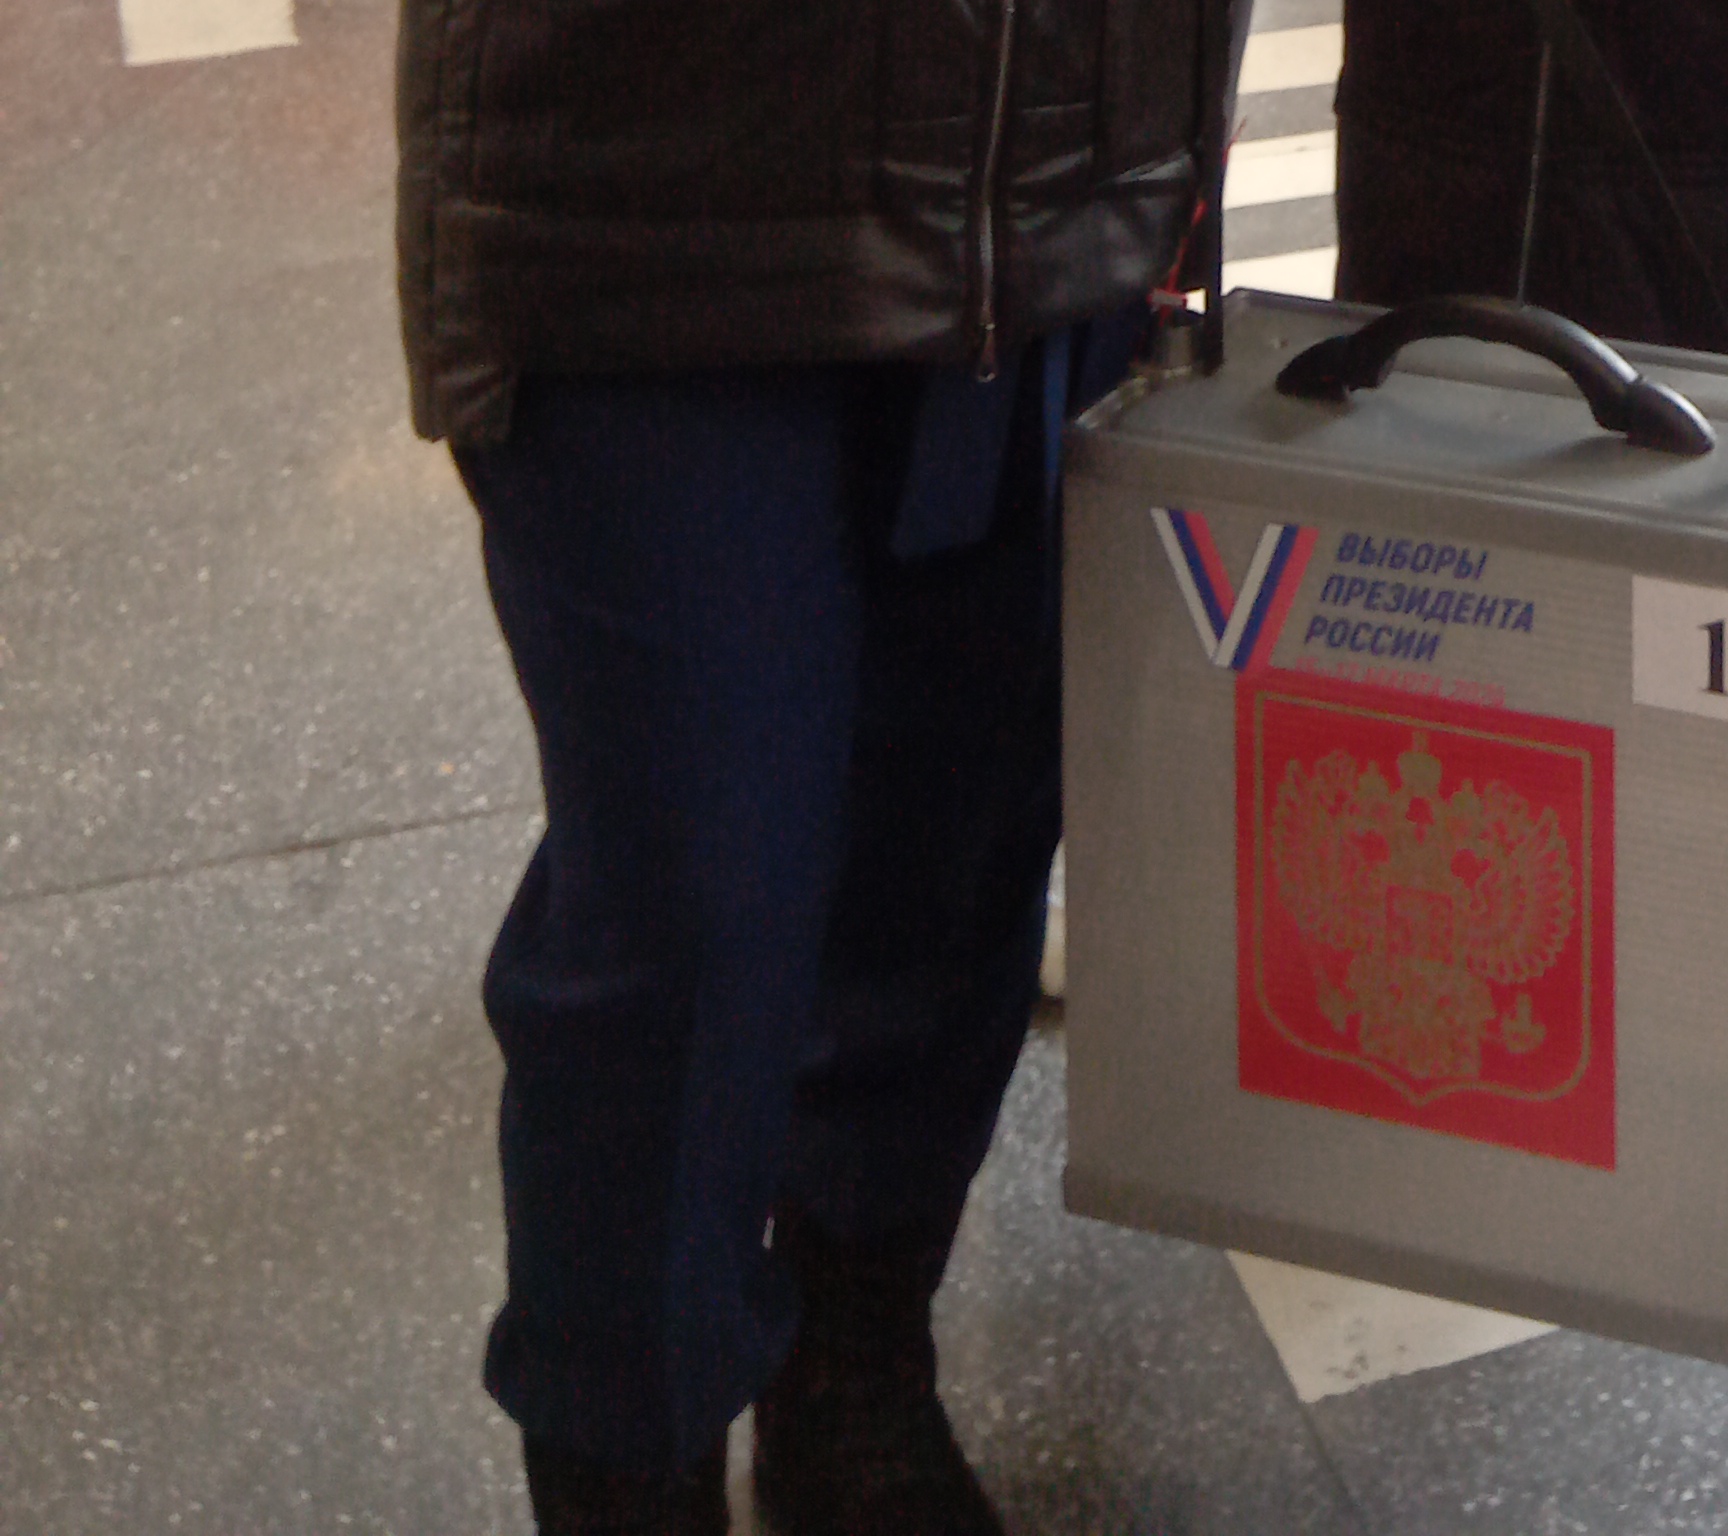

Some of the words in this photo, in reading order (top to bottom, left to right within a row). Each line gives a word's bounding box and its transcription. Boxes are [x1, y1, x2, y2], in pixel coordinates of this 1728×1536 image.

[1336, 531, 1488, 580] ВЫБОРЫ
[1319, 573, 1536, 634] ПРЕЗИДЕНТА
[1304, 614, 1442, 662] РОССИИ
